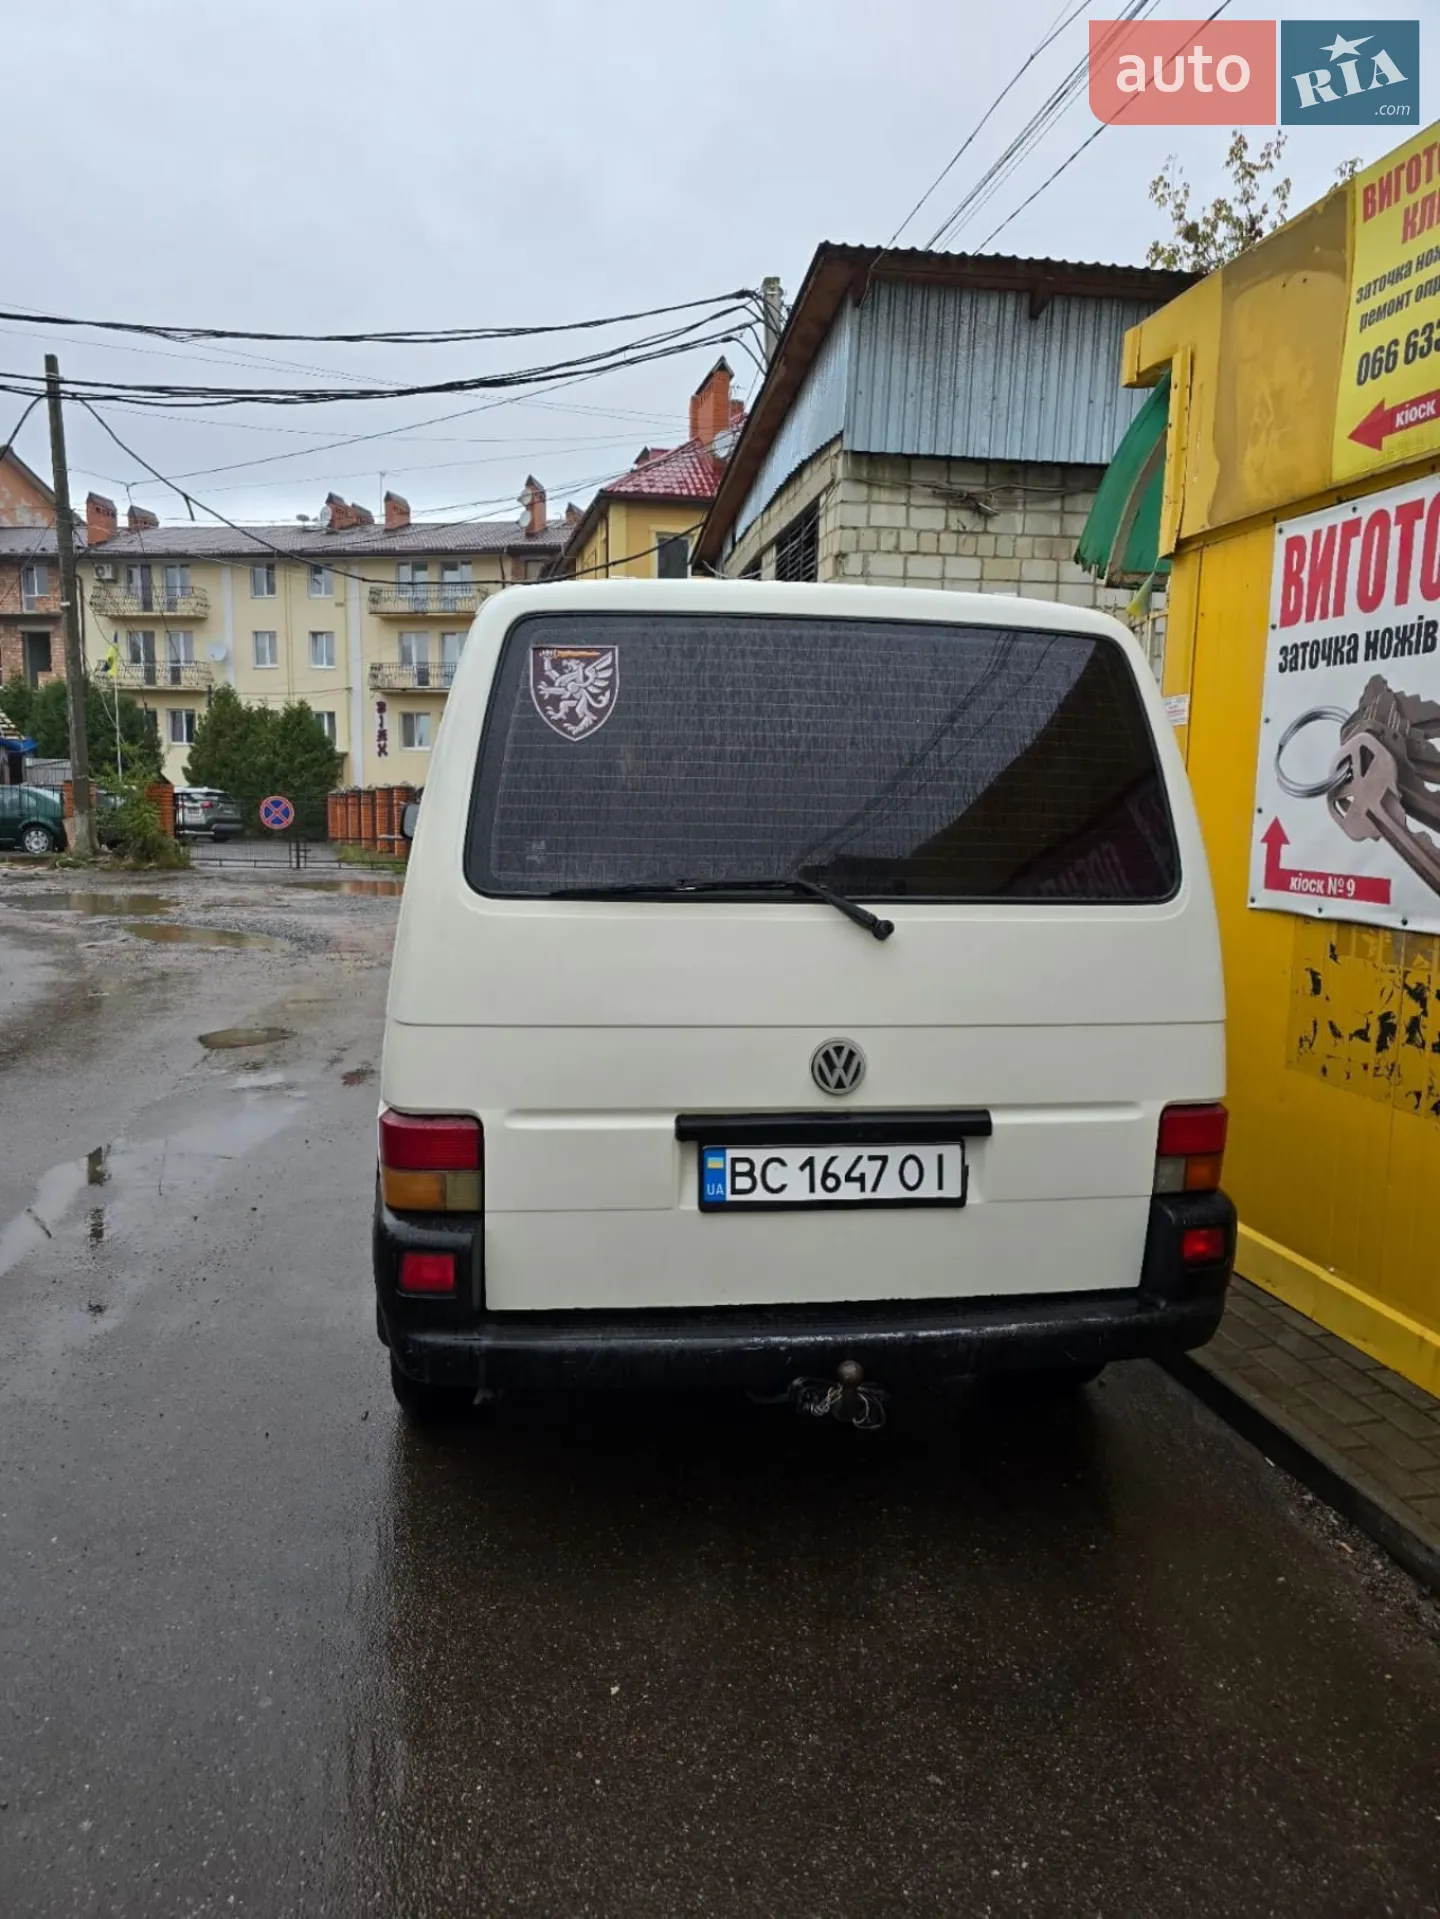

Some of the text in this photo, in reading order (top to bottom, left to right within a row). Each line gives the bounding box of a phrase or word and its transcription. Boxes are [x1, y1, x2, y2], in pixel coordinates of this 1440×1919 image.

[1362, 141, 1440, 223] ВИГОТ
[1401, 188, 1440, 245] КЛ
[1356, 259, 1413, 304] заточка
[1359, 288, 1413, 334] ремонт
[1356, 338, 1400, 386] 066
[1395, 400, 1437, 428] кіоск
[1278, 615, 1439, 674] заточка ножів
[1289, 872, 1325, 895] кіоск
[706, 1183, 725, 1197] UA
[798, 1154, 889, 1194] 1647
